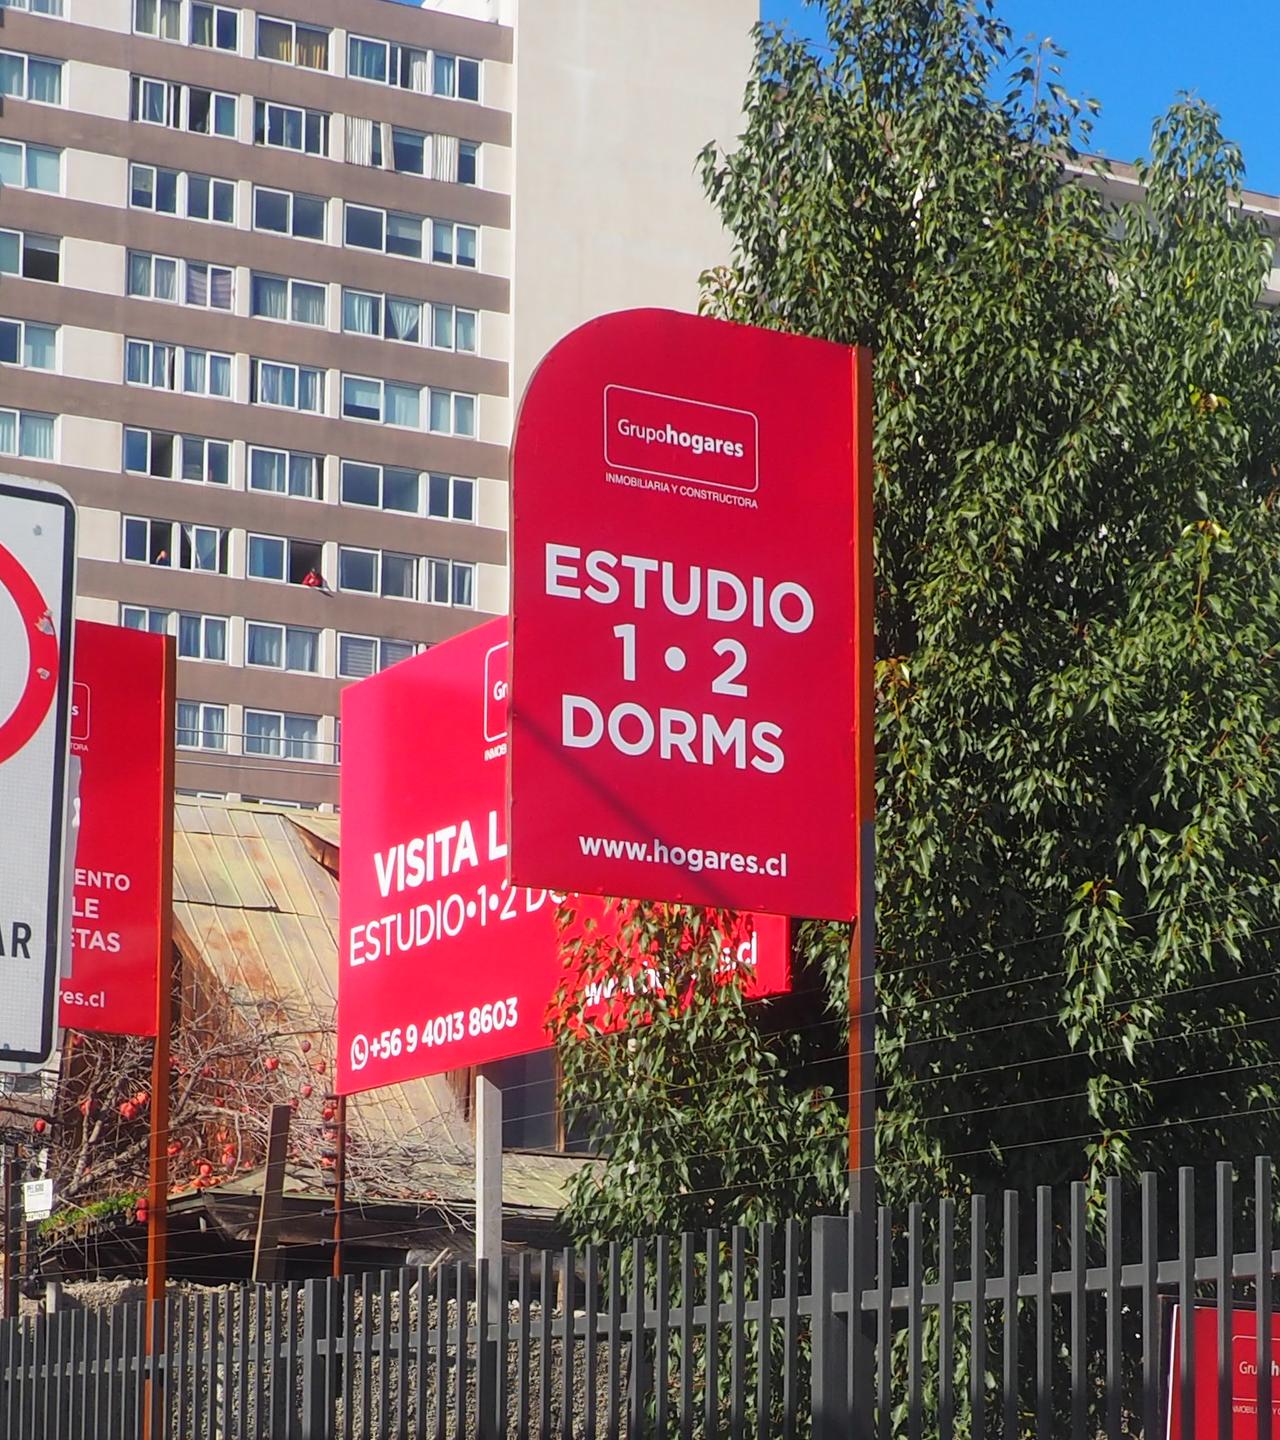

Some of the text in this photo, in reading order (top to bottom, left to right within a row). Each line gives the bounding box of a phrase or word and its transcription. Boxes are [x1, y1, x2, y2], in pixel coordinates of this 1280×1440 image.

[618, 419, 744, 457] Grupohogares
[605, 472, 758, 509] INMOBILIARIA Y CONSTRUCTORA
[545, 542, 814, 634] ESTUDIO
[711, 638, 748, 697] 2
[562, 694, 785, 774] DORMS
[374, 820, 478, 897] VISITA
[579, 835, 787, 877] www.hogares.cl
[370, 997, 518, 1060] +56 9 4013 8603
